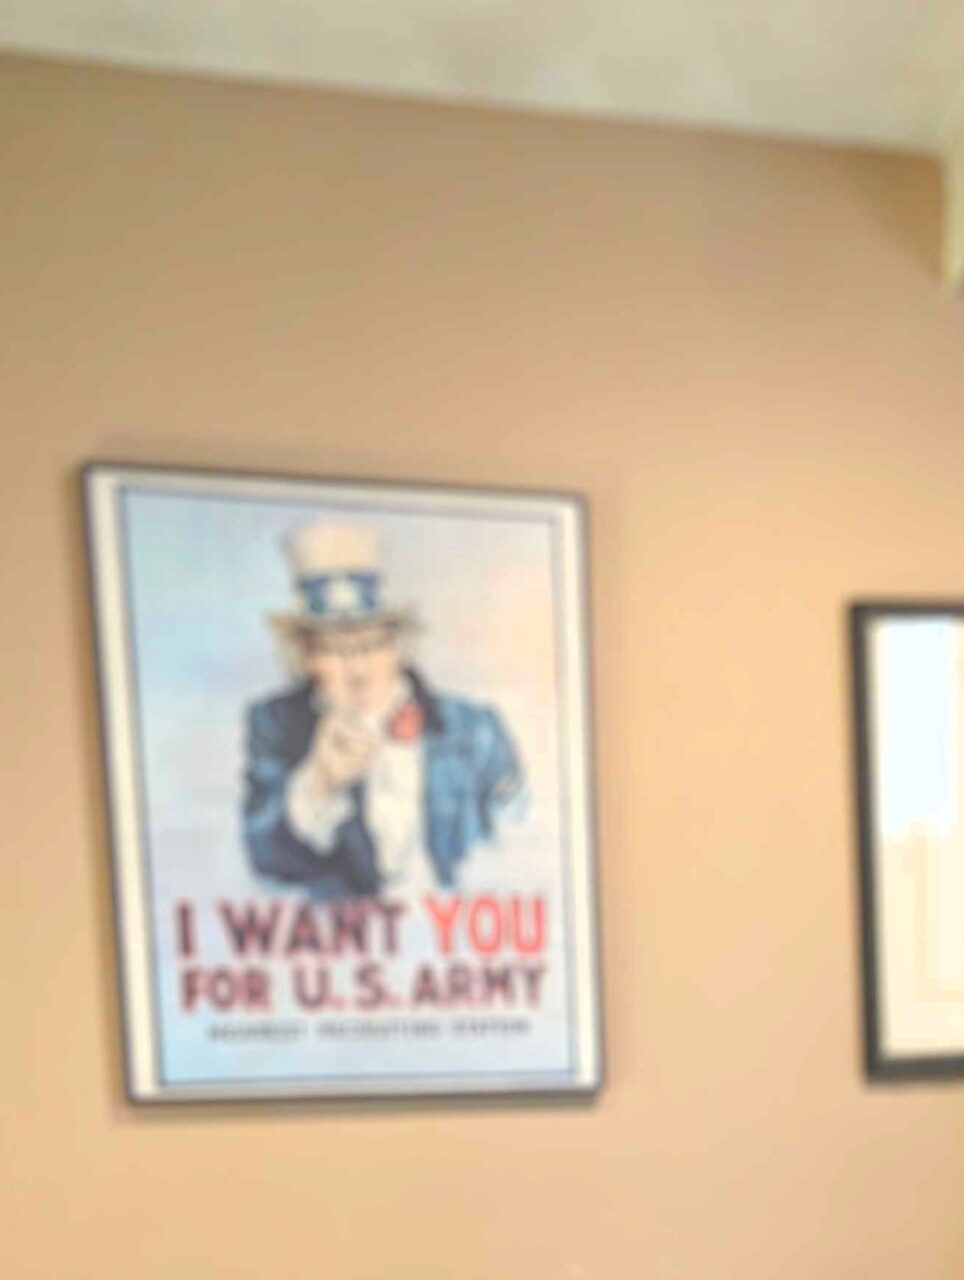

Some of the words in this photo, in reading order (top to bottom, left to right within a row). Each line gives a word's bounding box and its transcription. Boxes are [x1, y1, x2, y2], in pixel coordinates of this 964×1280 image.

[175, 899, 195, 957] I
[218, 897, 406, 956] WANT
[423, 891, 547, 955] YOU
[181, 966, 270, 1012] FOR
[410, 961, 547, 1007] ARMY
